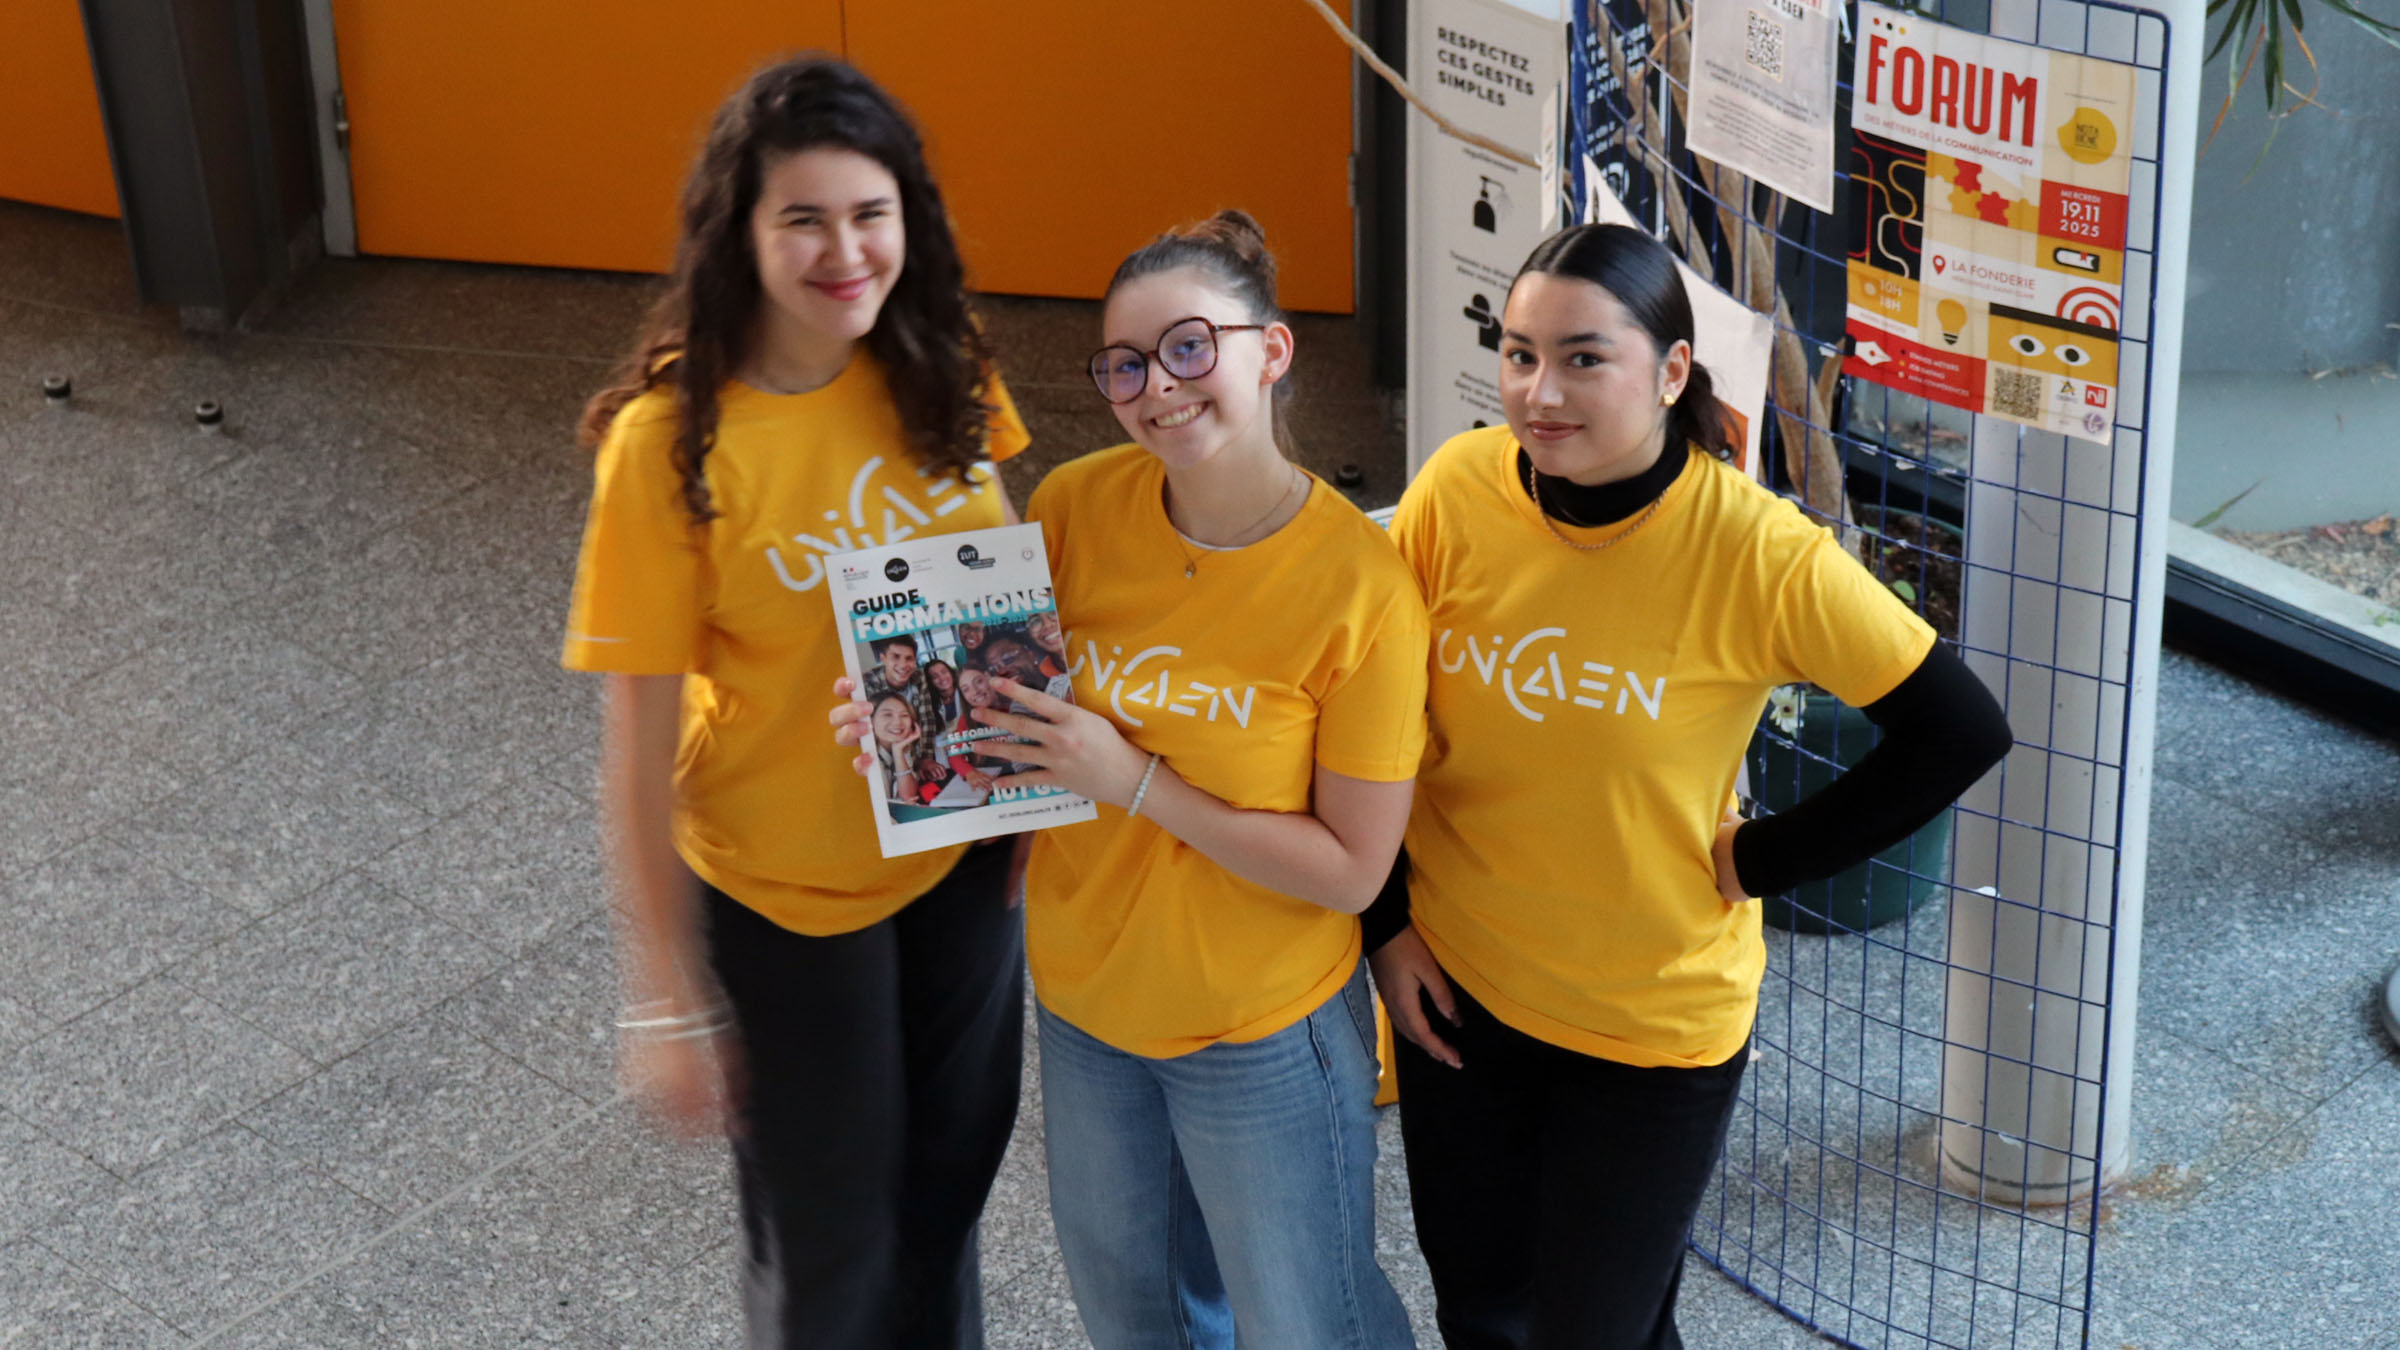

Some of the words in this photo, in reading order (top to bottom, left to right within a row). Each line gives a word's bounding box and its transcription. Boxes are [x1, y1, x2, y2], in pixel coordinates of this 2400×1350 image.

[1437, 26, 1530, 72] RESPECTEZ
[1437, 49, 1468, 70] CES
[1472, 62, 1534, 96] GESTES
[1437, 70, 1506, 106] SIMPLES
[1865, 33, 2038, 148] FORUM
[1864, 112, 1882, 126] DES
[1883, 117, 1918, 137] MÉTIERS
[1918, 129, 1930, 140] DE
[1931, 132, 1943, 144] LA
[1944, 137, 2034, 167] COMMUNICATION
[2060, 189, 2102, 203] MERCREDI
[2061, 199, 2101, 223] 19.11
[2059, 219, 2101, 239] 2025
[1951, 258, 1967, 273] LA
[1969, 264, 2036, 290] FONDERIE
[1879, 279, 1903, 297] 10H
[1879, 295, 1901, 312] 18H
[852, 588, 921, 615] GUIDE
[854, 586, 1052, 640] FORMATIONS
[947, 731, 961, 743] SE
[949, 744, 959, 754] &
